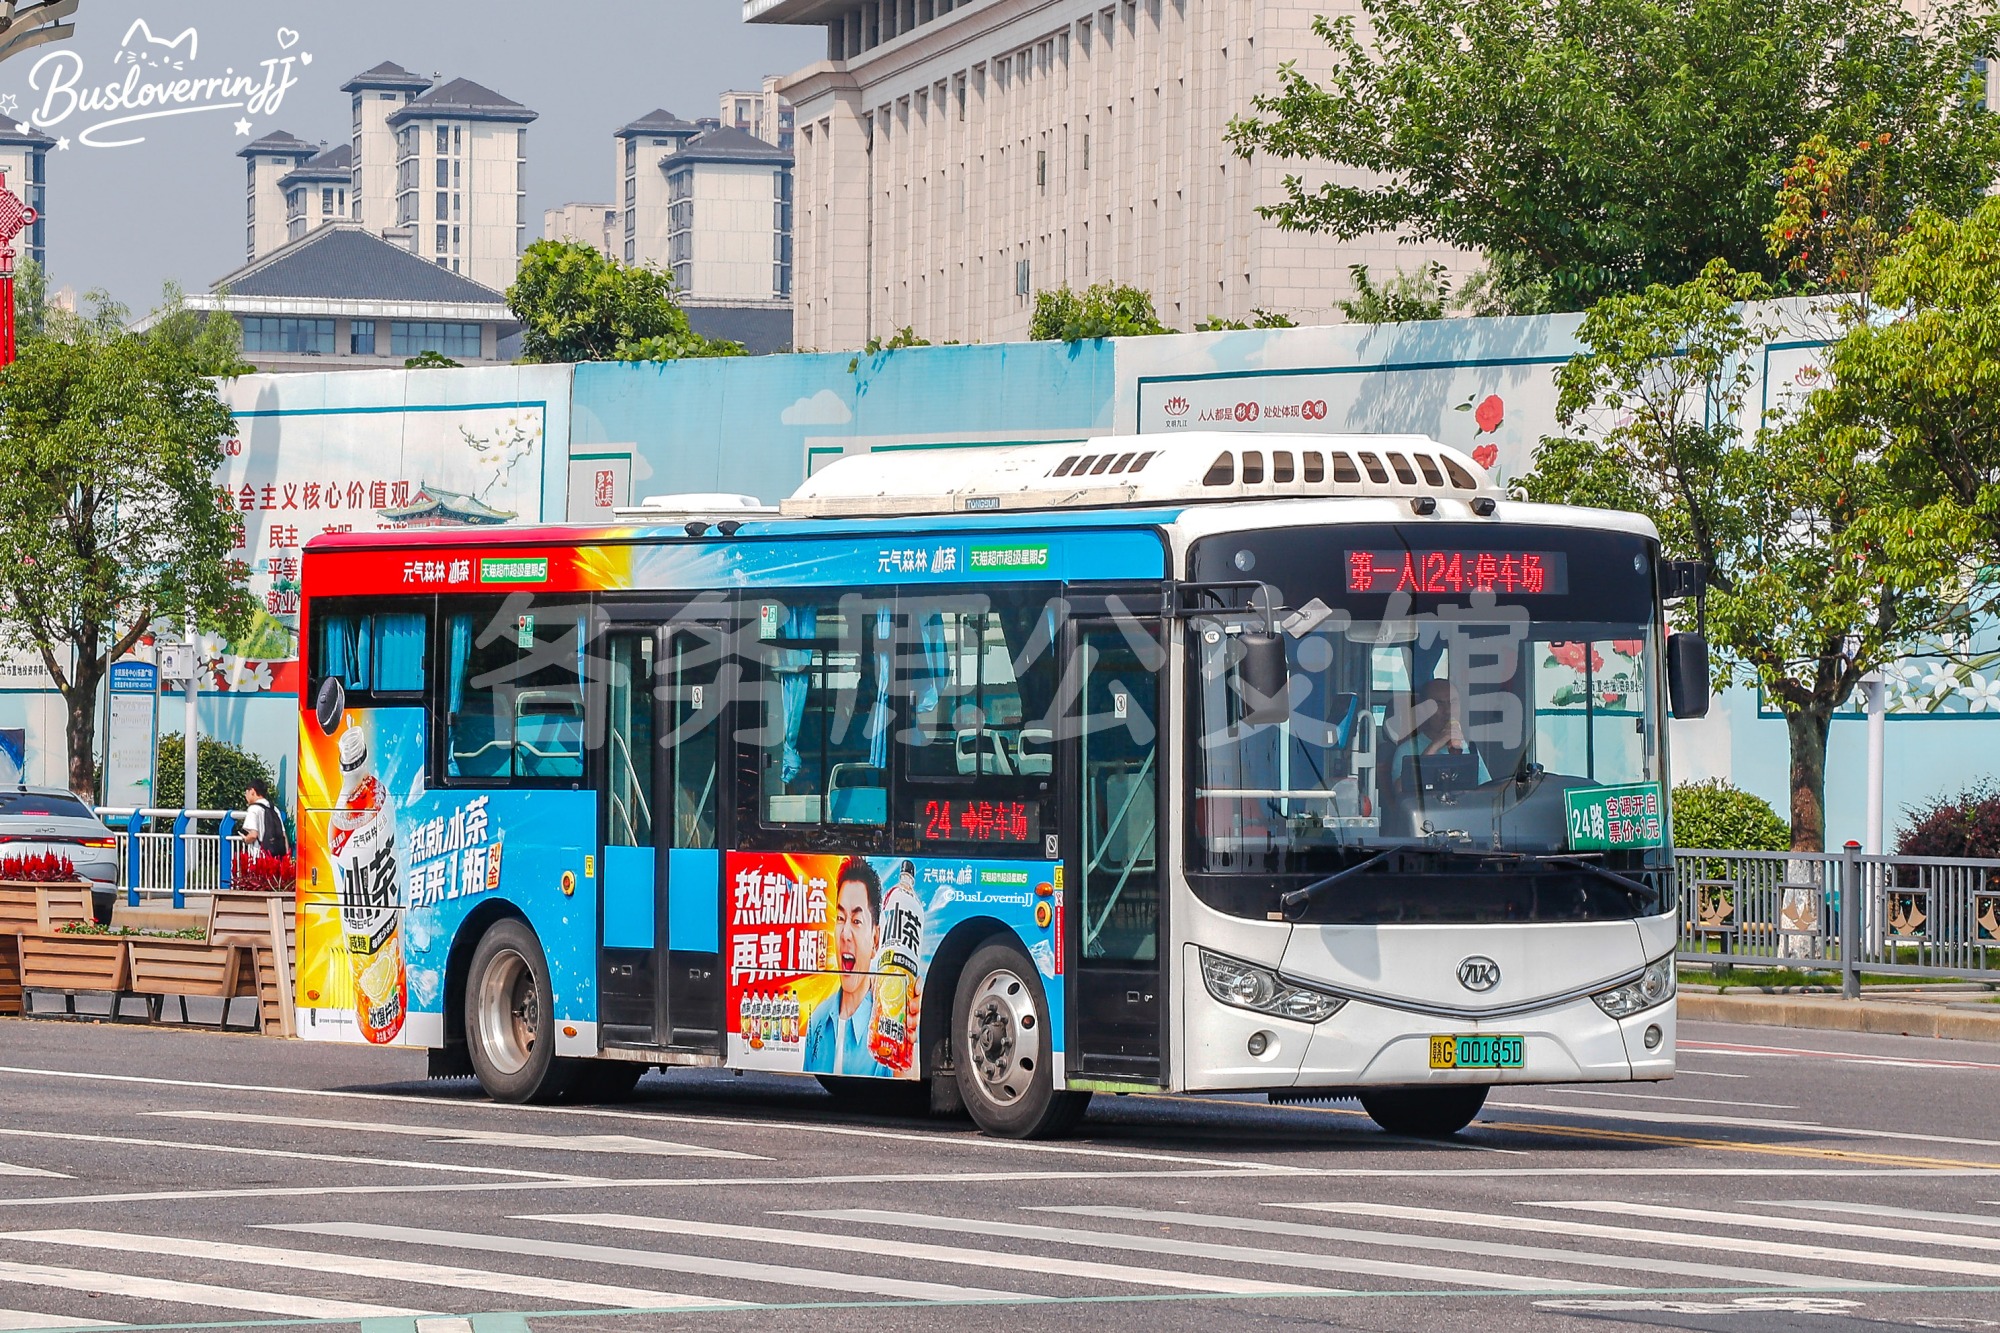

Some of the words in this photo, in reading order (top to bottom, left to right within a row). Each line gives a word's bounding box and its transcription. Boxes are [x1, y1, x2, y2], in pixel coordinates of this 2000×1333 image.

[269, 524, 299, 549] 民主
[267, 557, 298, 581] 平等
[403, 561, 435, 583] 元气森林
[438, 558, 470, 583] 冰茶
[482, 563, 546, 577] 天猫超市超级星期5
[878, 548, 927, 573] 元气森林
[931, 546, 956, 573] 冰茶
[971, 549, 1047, 566] 天猫超市超级星期5
[267, 591, 297, 615] 敬业
[409, 795, 489, 865] 热就冰茶
[925, 801, 952, 839] 24
[1573, 803, 1605, 840] 24路
[1606, 793, 1657, 819] 空调开启
[1608, 817, 1659, 844] 票价+1元
[408, 847, 487, 911] 再来1瓶
[923, 868, 955, 884] 元气森林
[733, 864, 828, 925] 热就冰茶
[731, 928, 818, 987] 再来1瓶
